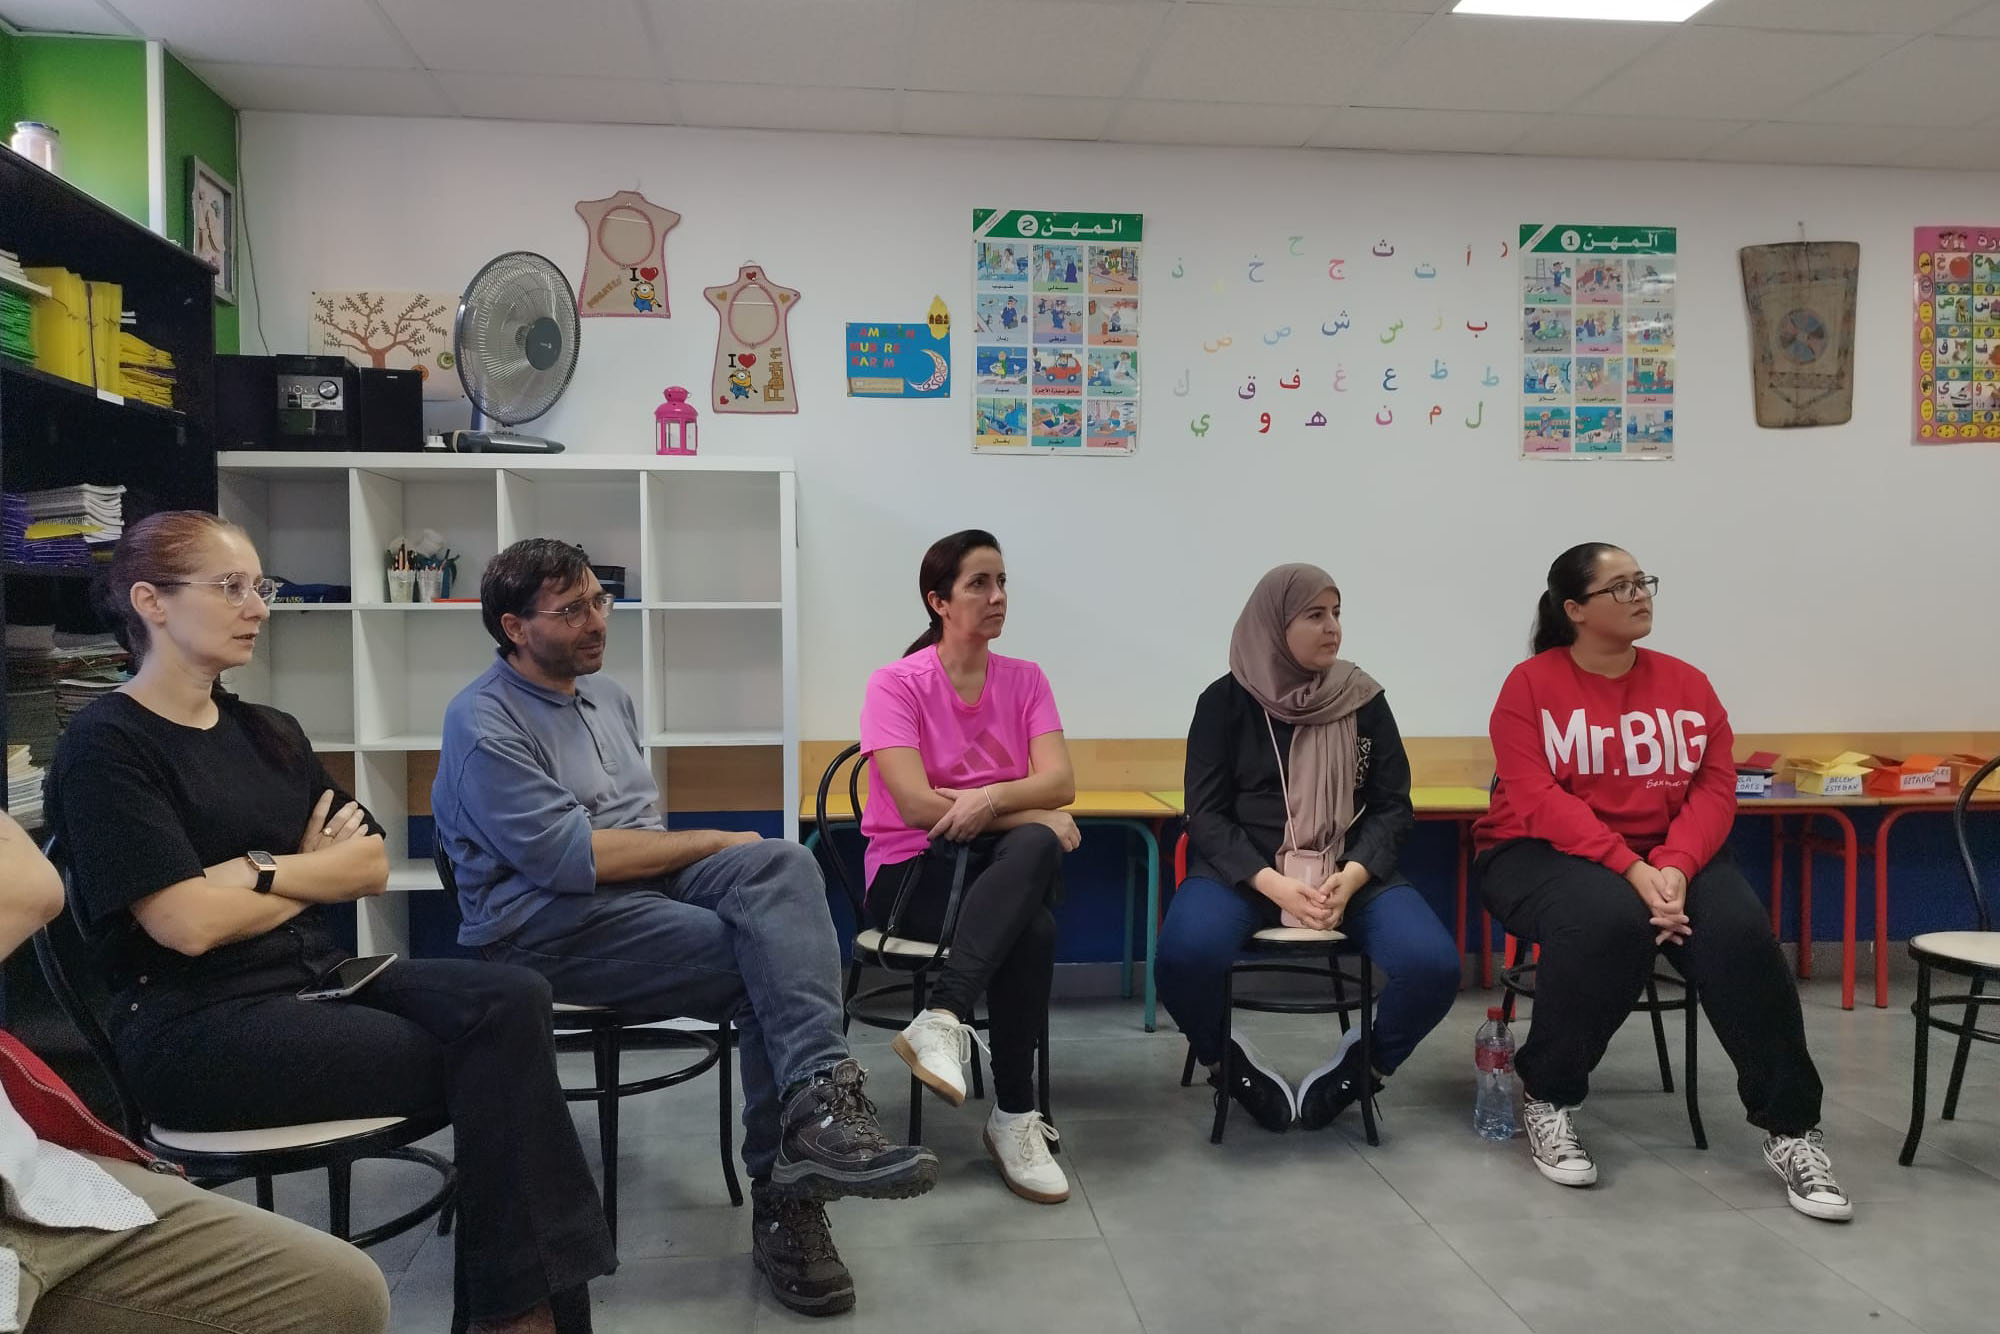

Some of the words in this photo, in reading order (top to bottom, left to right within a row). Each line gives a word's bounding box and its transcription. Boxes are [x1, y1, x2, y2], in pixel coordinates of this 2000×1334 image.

[1021, 220, 1035, 231] 2
[1041, 217, 1122, 237] المهن
[1287, 235, 1305, 257] ح
[1372, 239, 1395, 258] ث
[1583, 231, 1658, 250] المهن
[1248, 254, 1265, 283] خ
[1328, 258, 1345, 281] ج
[1414, 263, 1437, 280] ت
[1321, 309, 1351, 337] ش
[1378, 318, 1406, 345] س
[1466, 320, 1488, 339] ب
[728, 353, 740, 368] I
[1430, 358, 1449, 380] ظ
[1279, 368, 1301, 389] ف
[1333, 363, 1348, 392] غ
[1382, 367, 1399, 392] ع
[1480, 365, 1500, 387] ط
[1238, 375, 1256, 400] ق
[1190, 413, 1211, 438] ي
[1258, 412, 1271, 434] و
[1375, 404, 1393, 425] ن
[1429, 404, 1443, 426] م
[1464, 400, 1484, 429] ل
